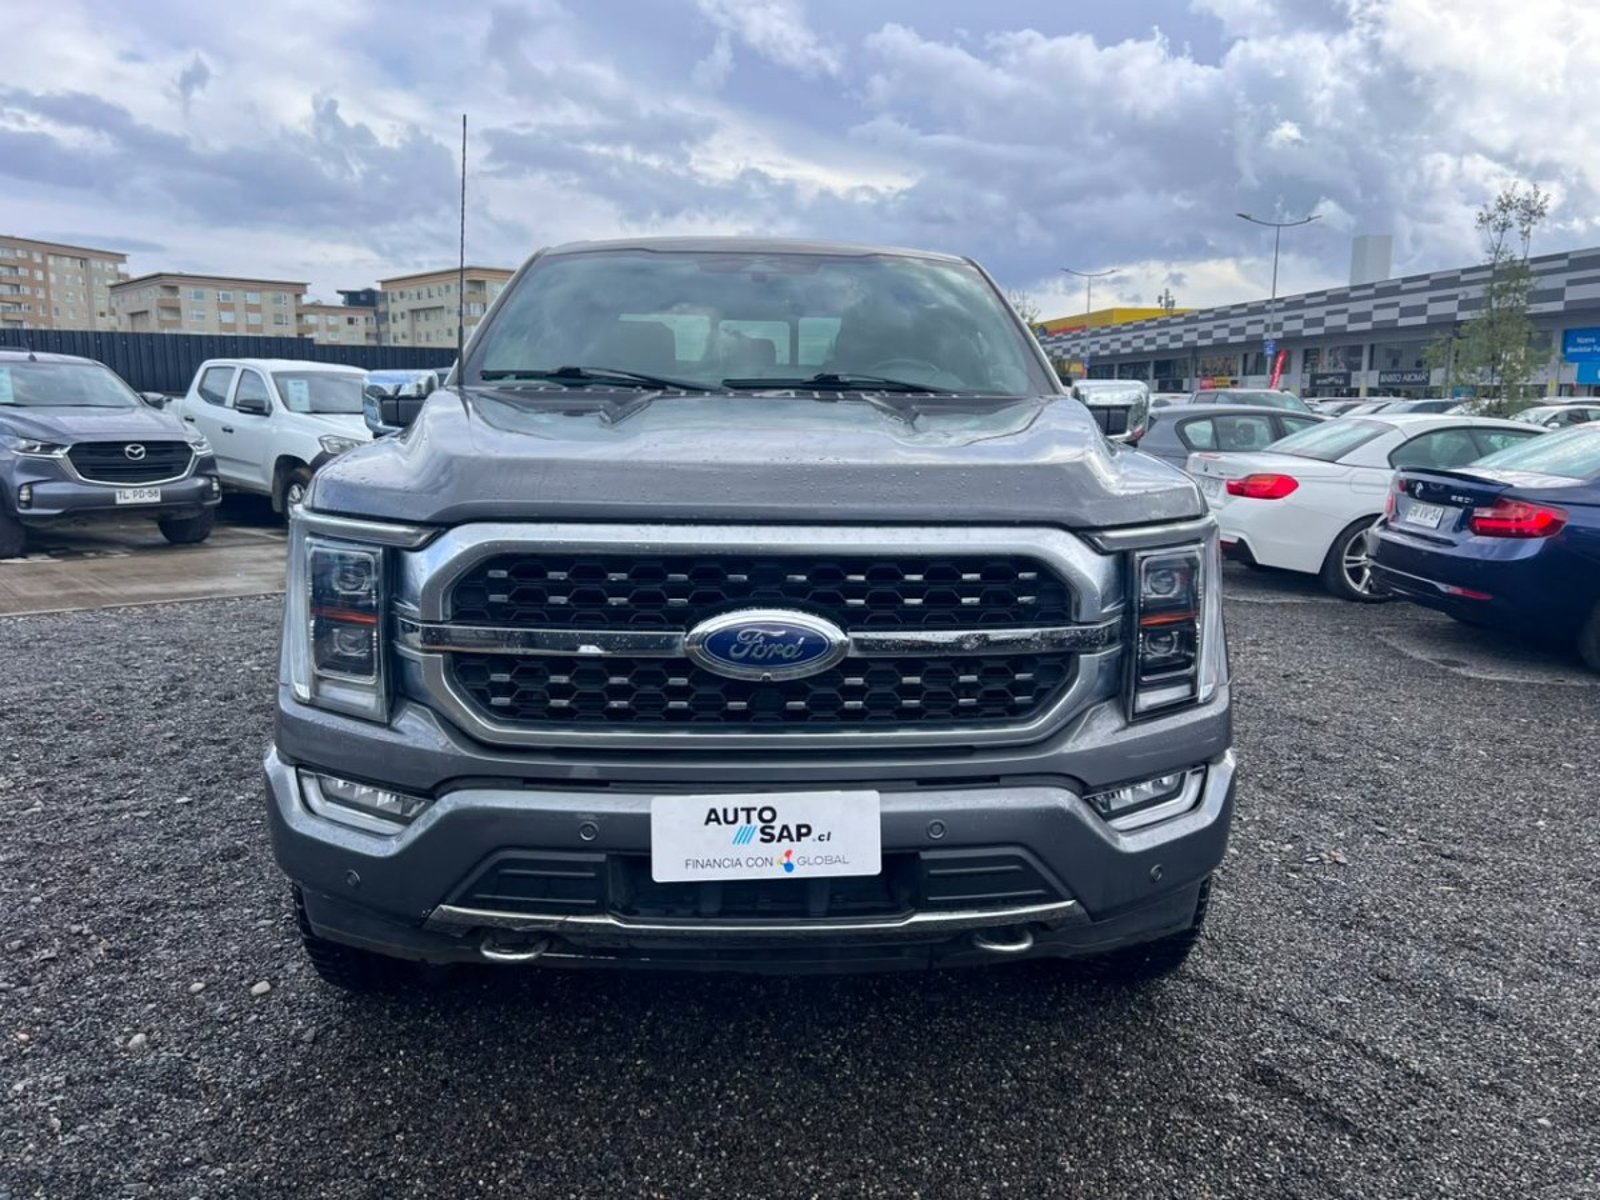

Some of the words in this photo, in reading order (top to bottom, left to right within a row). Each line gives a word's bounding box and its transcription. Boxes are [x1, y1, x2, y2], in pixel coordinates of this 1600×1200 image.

[729, 628, 804, 659] Ford
[704, 806, 777, 826] AUTO
[685, 857, 742, 870] FINANCIA
[746, 856, 774, 868] CON
[797, 855, 850, 867] GLOBAL
